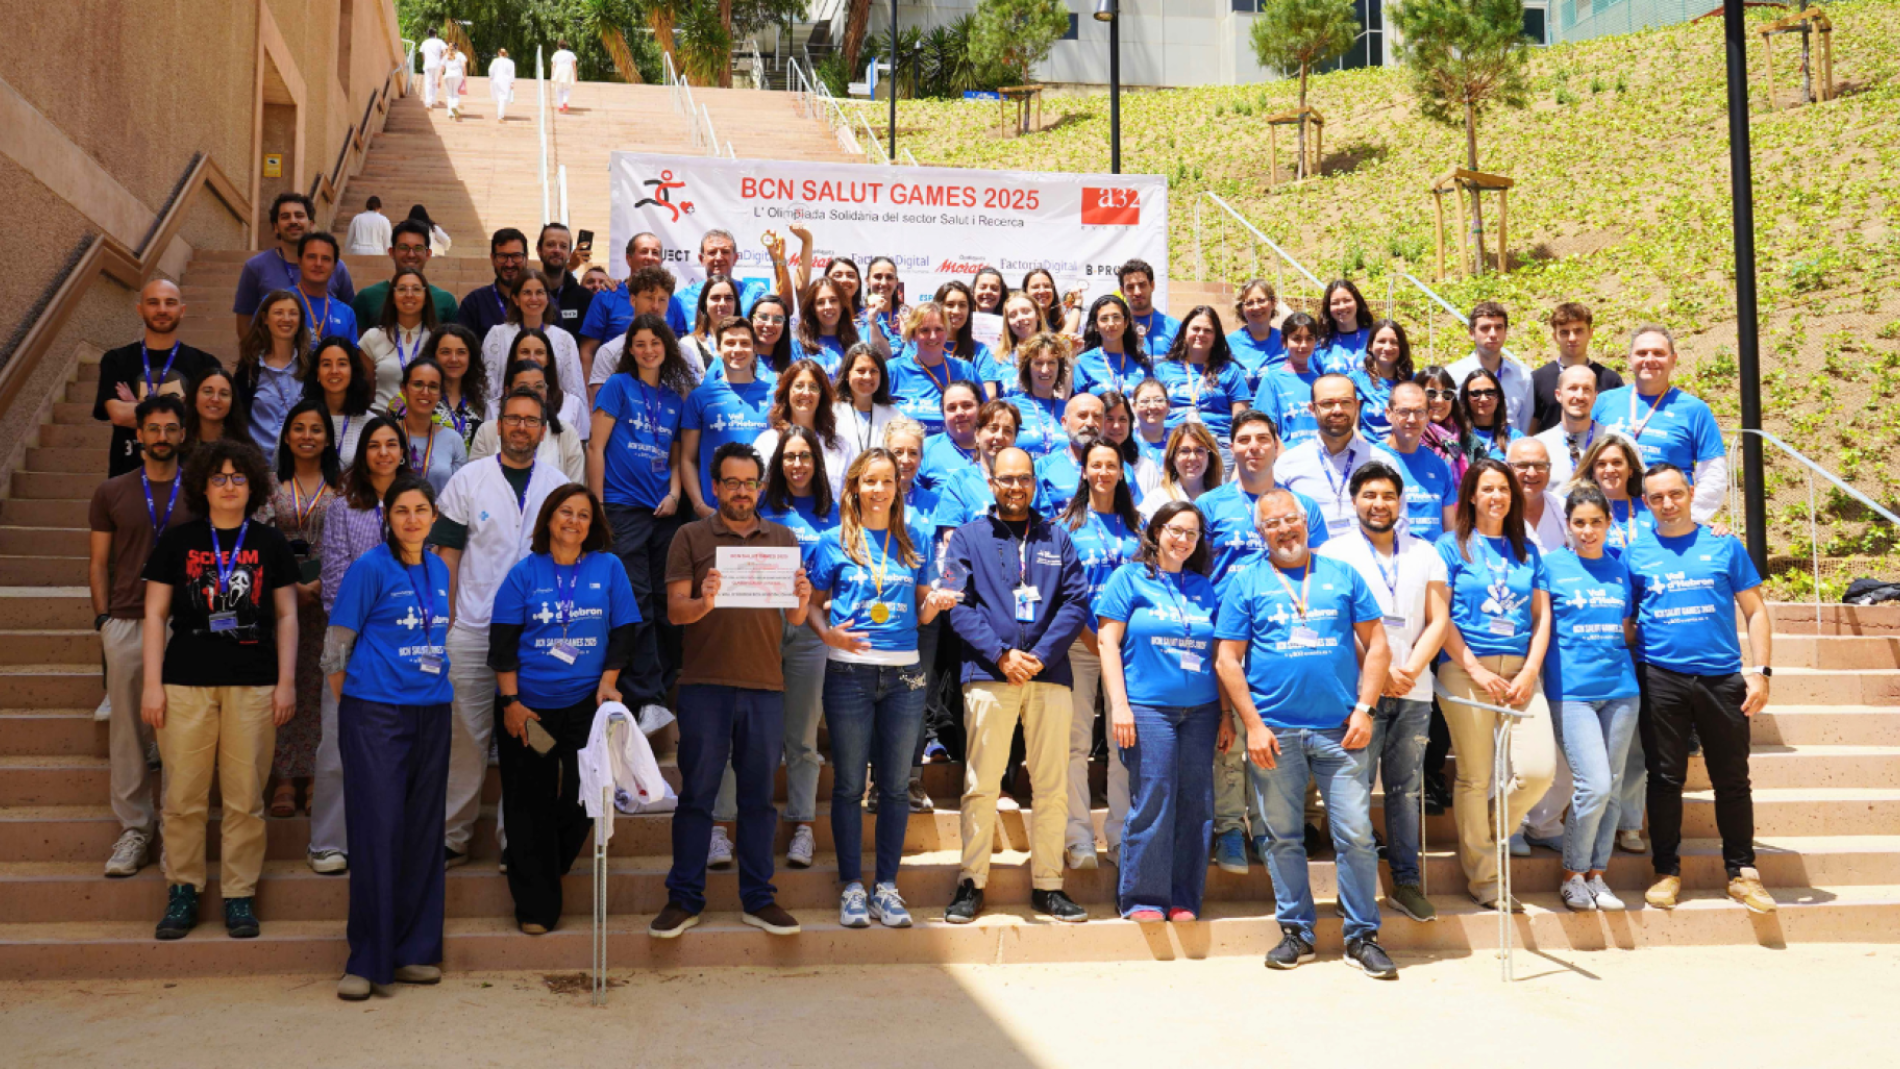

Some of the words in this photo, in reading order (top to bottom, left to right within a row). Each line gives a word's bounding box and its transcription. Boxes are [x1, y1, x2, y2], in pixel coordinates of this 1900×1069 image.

[741, 177, 794, 200] BCN
[802, 179, 883, 204] SALUT
[890, 184, 977, 208] GAMES
[984, 187, 1040, 211] 2025
[1098, 186, 1140, 208] a32
[882, 211, 899, 223] del
[902, 214, 936, 225] sector
[940, 213, 970, 226] Salut
[978, 215, 1024, 228] Recerca
[727, 412, 745, 420] Vall
[1665, 571, 1685, 581] Vall
[1667, 579, 1715, 588] d'Hebron
[1587, 589, 1606, 597] Vall
